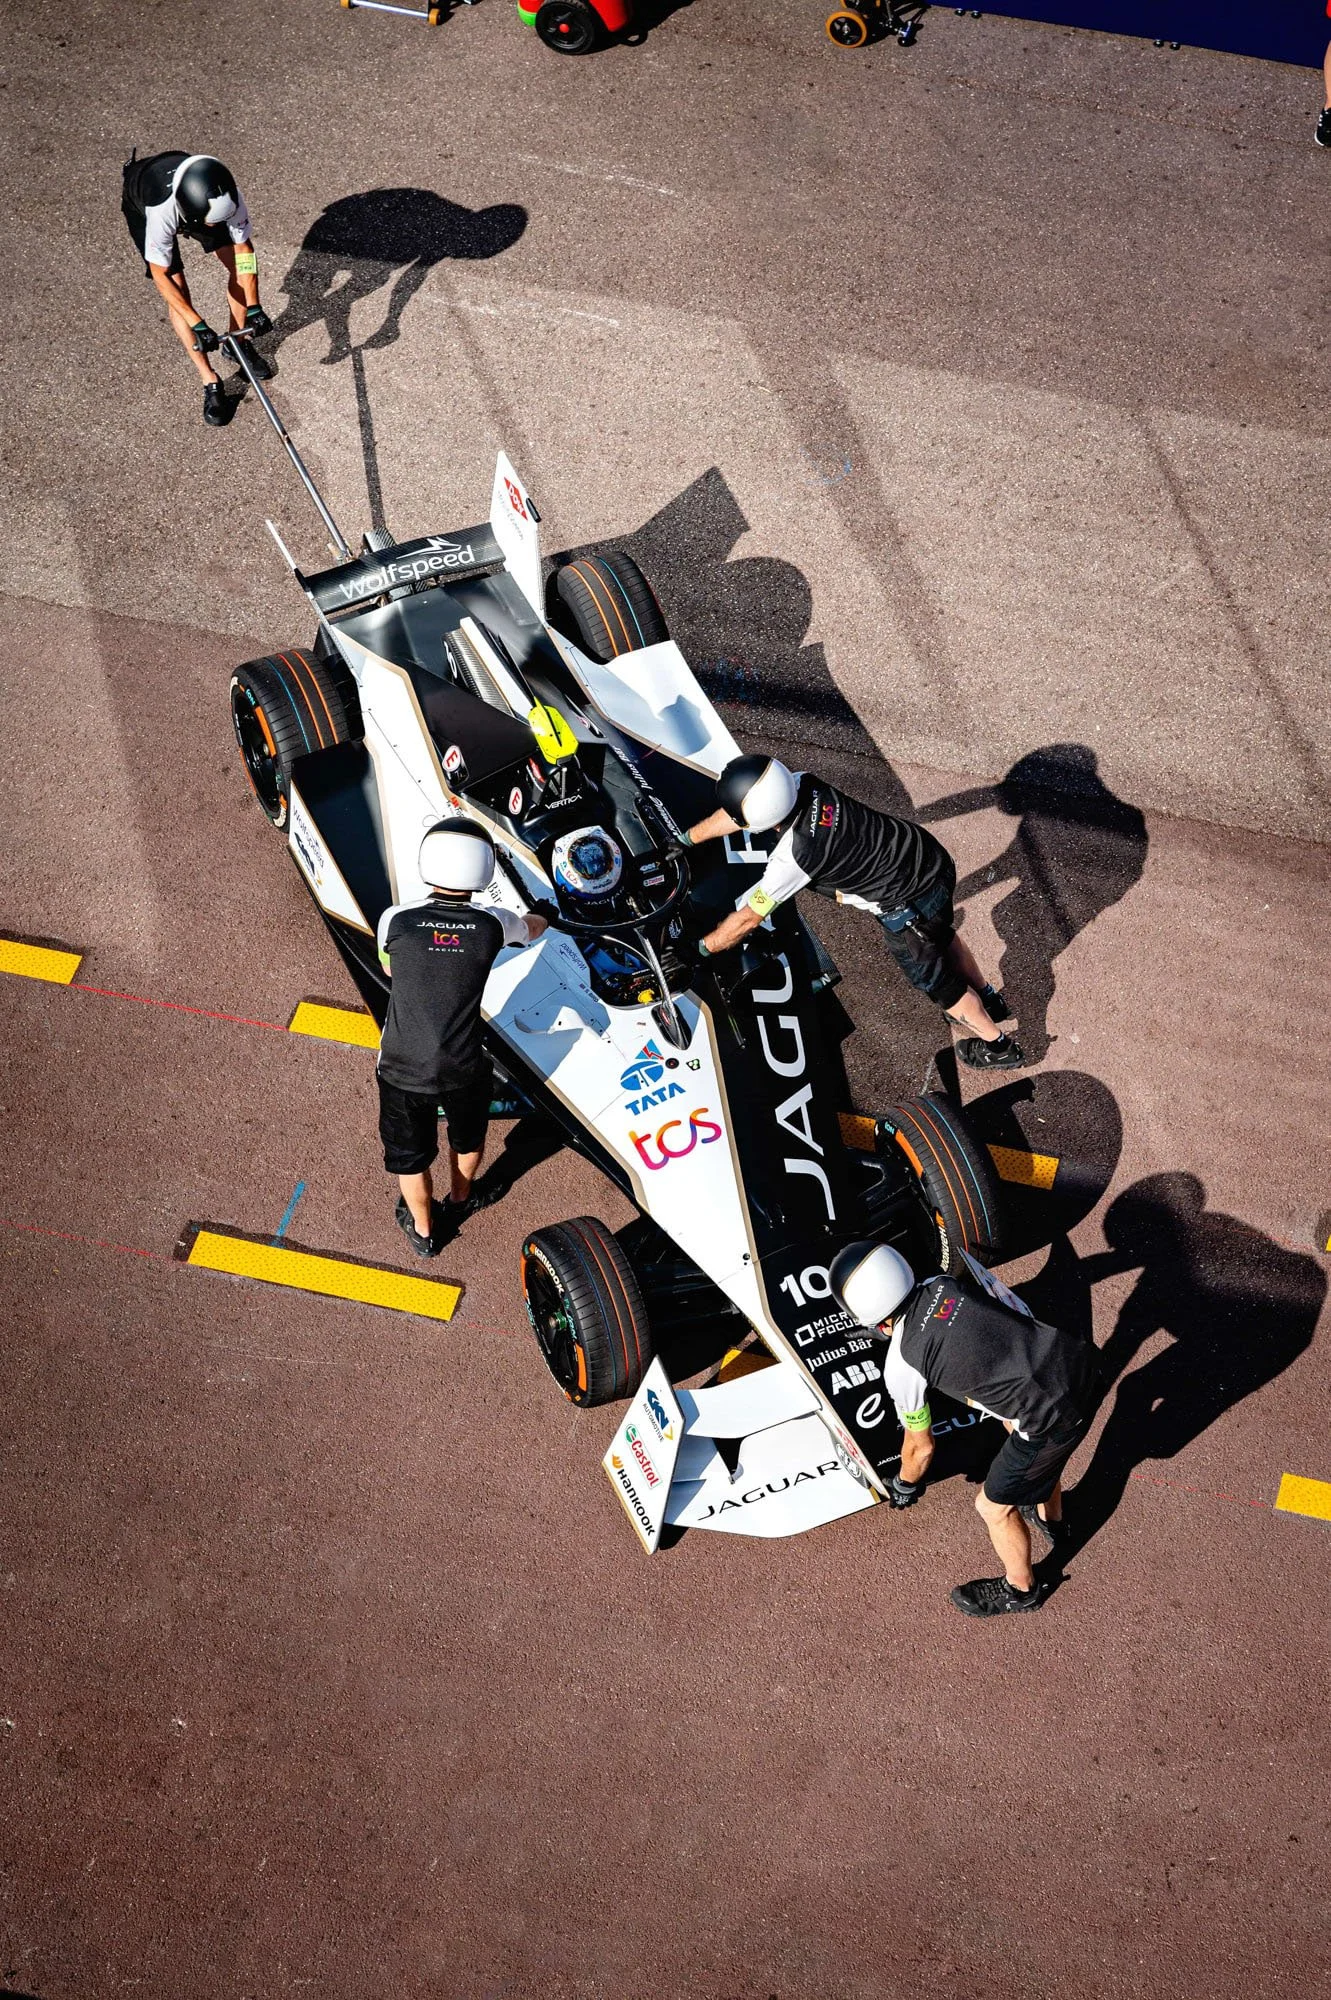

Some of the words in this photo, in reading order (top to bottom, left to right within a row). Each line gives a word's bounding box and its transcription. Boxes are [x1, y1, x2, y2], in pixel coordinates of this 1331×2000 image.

[339, 545, 475, 599] Wolfspeed
[545, 795, 582, 810] VERTICA
[809, 789, 819, 838] JAGUAR
[819, 804, 834, 827] tcs
[487, 881, 503, 904] Bär
[417, 921, 477, 930] JAGUAR
[433, 930, 460, 946] tcs
[625, 1082, 686, 1116] TATA
[628, 1107, 722, 1171] tcs
[779, 1265, 833, 1307] 10
[813, 1312, 849, 1329] MICR
[920, 1285, 944, 1332] JAGUAR
[934, 1298, 956, 1320] tcs
[948, 1297, 965, 1327] RACING
[806, 1347, 848, 1373] Julius
[847, 1338, 873, 1353] Bär
[831, 1360, 882, 1396] ABB
[643, 1403, 664, 1442] AUTOMOTIVE
[631, 1440, 660, 1487] Castrol
[877, 1454, 901, 1467] JAGUA
[698, 1460, 841, 1521] JAGUAR
